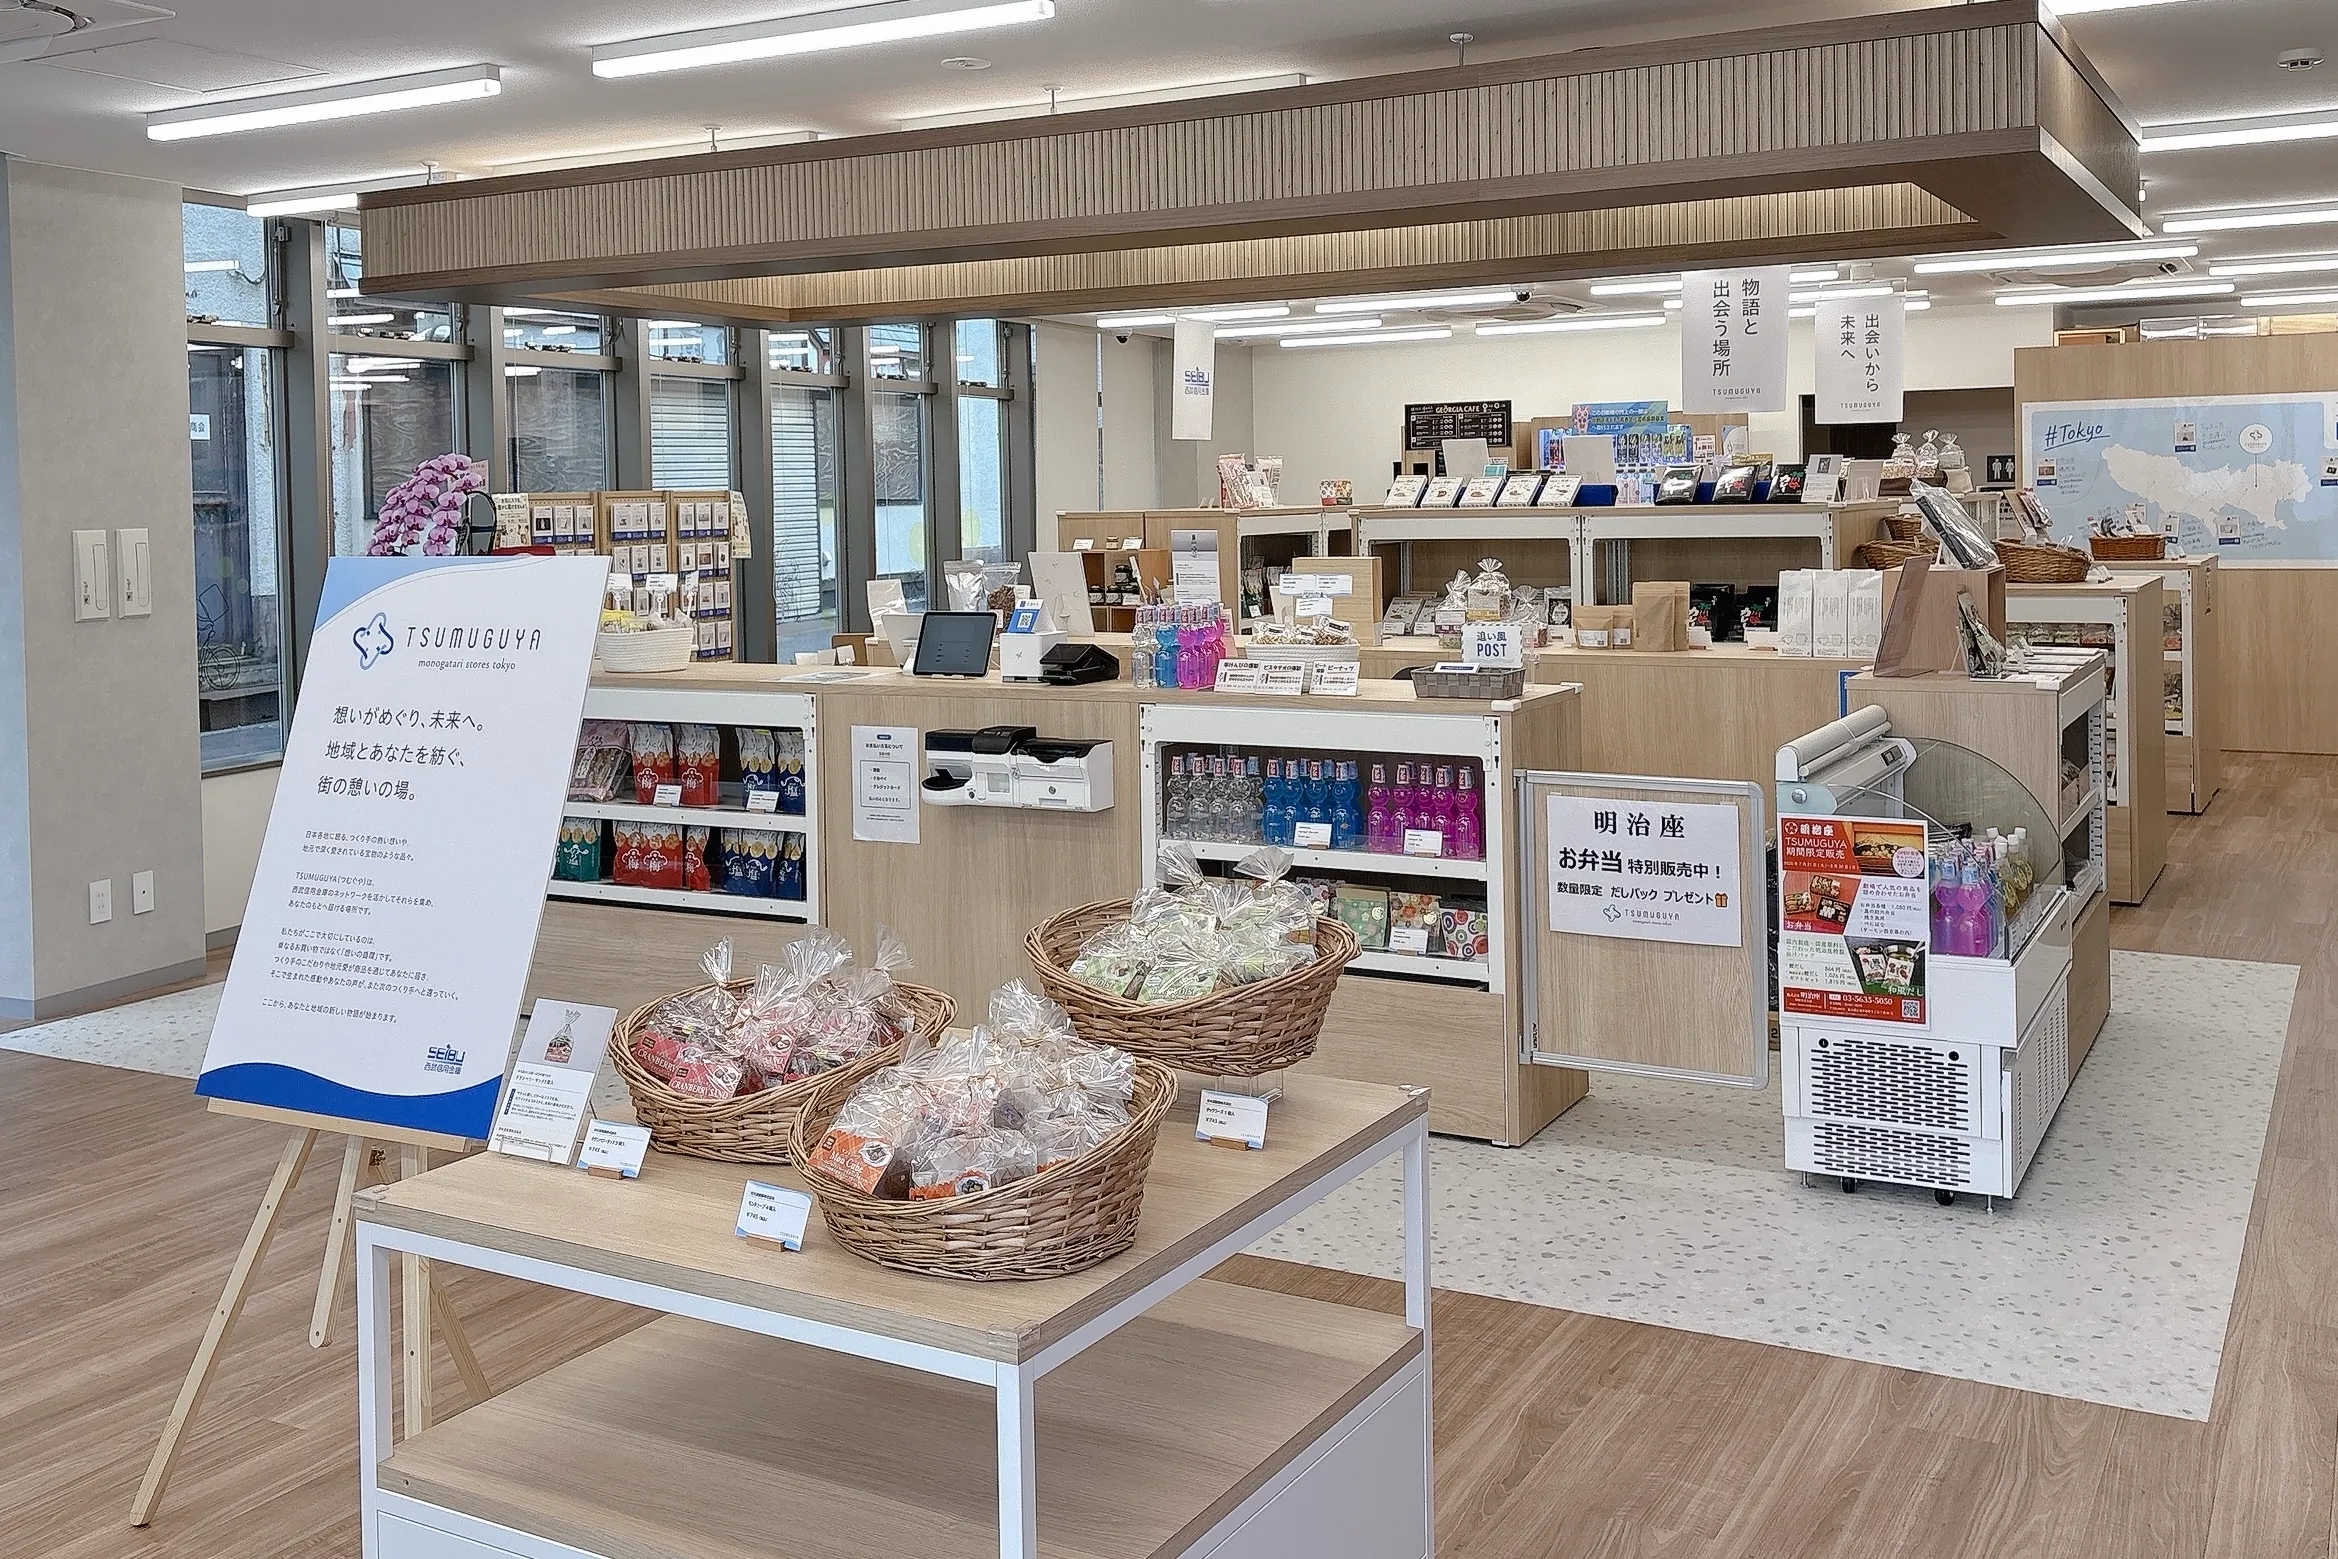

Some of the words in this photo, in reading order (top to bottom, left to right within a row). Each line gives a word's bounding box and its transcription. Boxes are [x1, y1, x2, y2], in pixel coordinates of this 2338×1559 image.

[1741, 278, 1760, 336] 物語と
[1712, 279, 1731, 377] 出会う場所
[1840, 314, 1856, 360] 未来へ
[1865, 313, 1881, 393] 出会いから
[2044, 424, 2104, 447] #Tokyo
[406, 626, 541, 651] TSUMUGUYA
[1476, 630, 1507, 643] 追い風
[1476, 643, 1508, 658] POST
[418, 658, 464, 671] monogatari
[465, 660, 491, 670] stores
[491, 659, 516, 673] tokyo
[332, 706, 485, 732] 想いがめぐり、未来へ。
[325, 741, 465, 769] 地域とあなたを紡ぐ、
[317, 775, 417, 802] 街の憩いの場。
[1593, 810, 1686, 839] 明治座
[1785, 837, 1848, 849] TSUMUGUYA
[1785, 847, 1846, 860] 期間限定販売
[1558, 847, 1623, 874] お弁当
[1627, 858, 1721, 880] 特別販売中！
[1556, 881, 1603, 898] 数量限定
[1610, 885, 1658, 901] だしパック
[1663, 889, 1714, 905] プレゼント
[1624, 908, 1680, 921] TSUMUGUYA
[1786, 920, 1812, 931] お弁当
[1887, 984, 1924, 996] 和風だし
[427, 1044, 467, 1064] SEIBU
[637, 1049, 678, 1073] CRANBERRY
[671, 1080, 709, 1097] CRANBERRY
